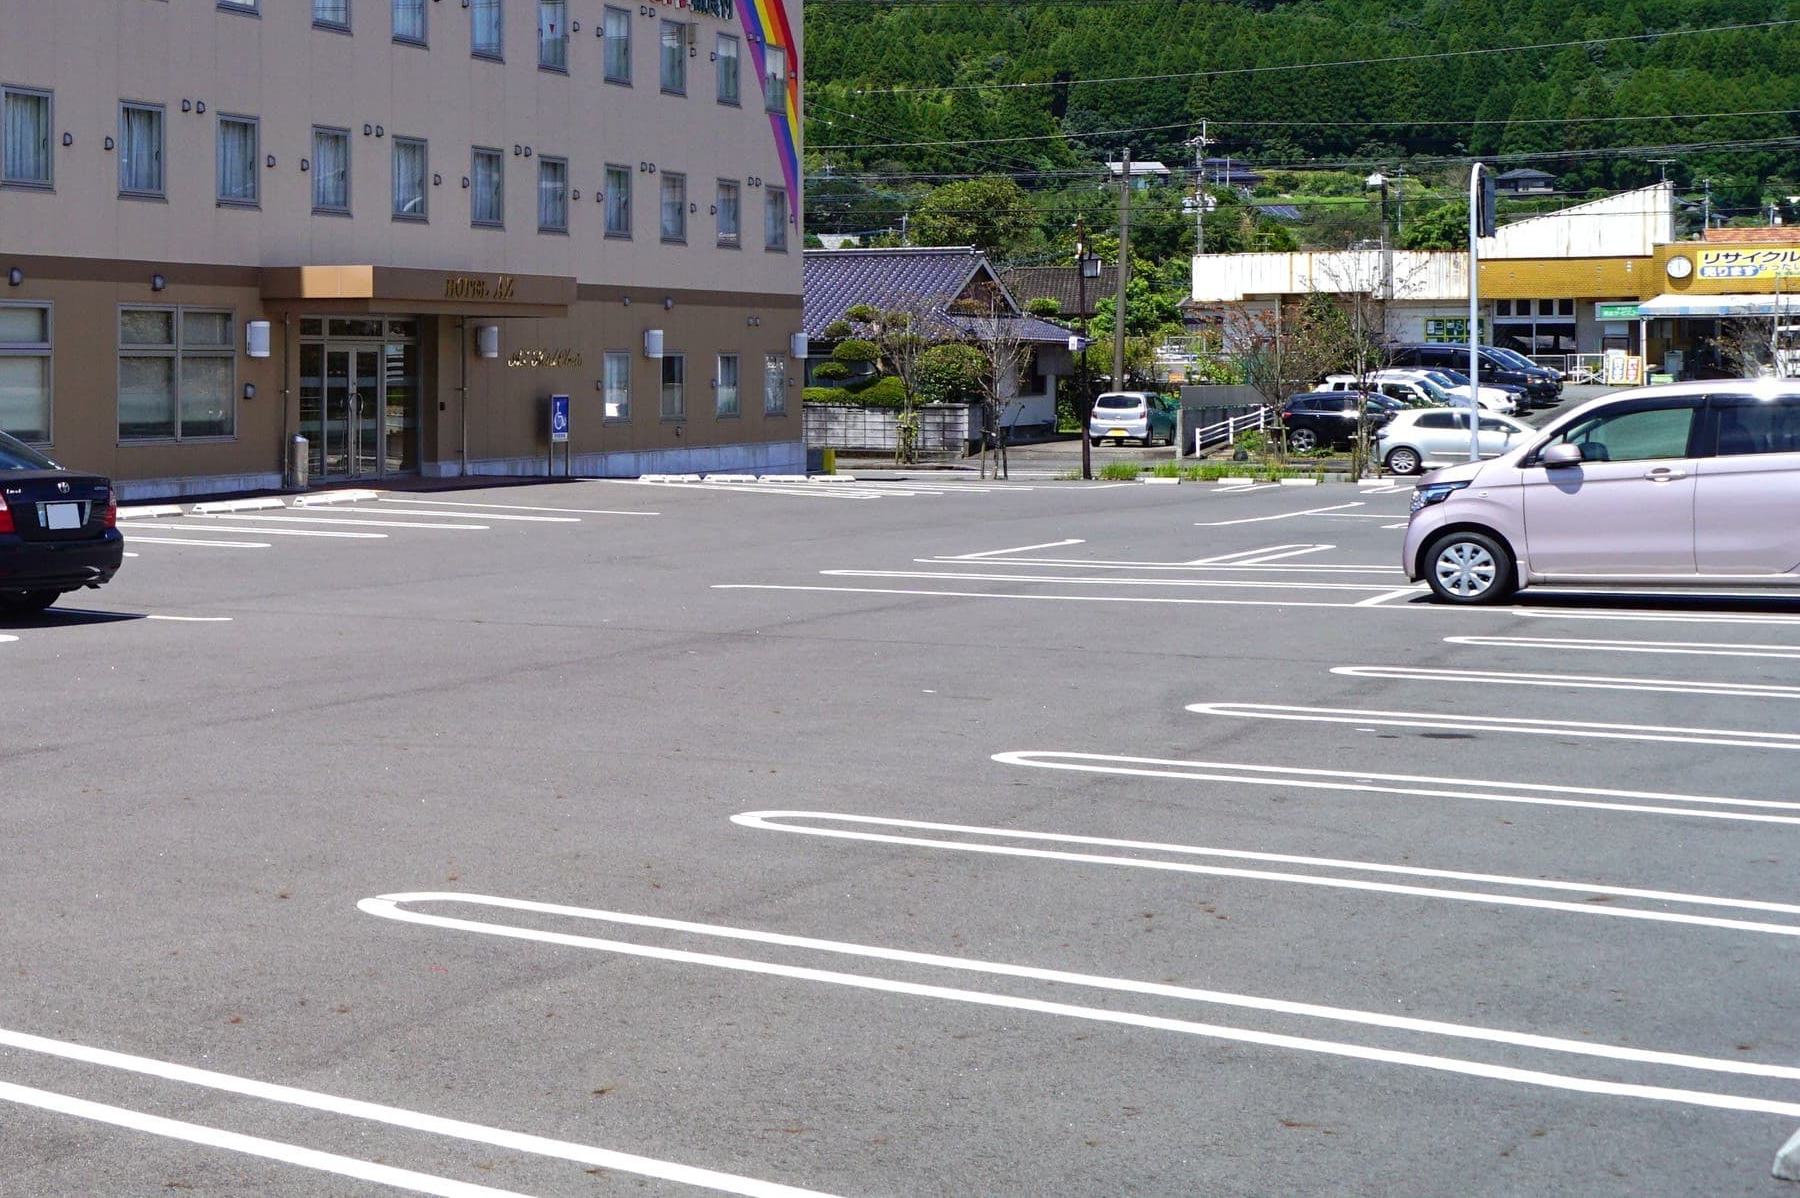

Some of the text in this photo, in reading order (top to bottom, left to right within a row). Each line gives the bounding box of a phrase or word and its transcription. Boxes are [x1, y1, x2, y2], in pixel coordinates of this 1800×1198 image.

[1703, 250, 1800, 265] リサイクル
[445, 275, 515, 299] HOTEL AZ
